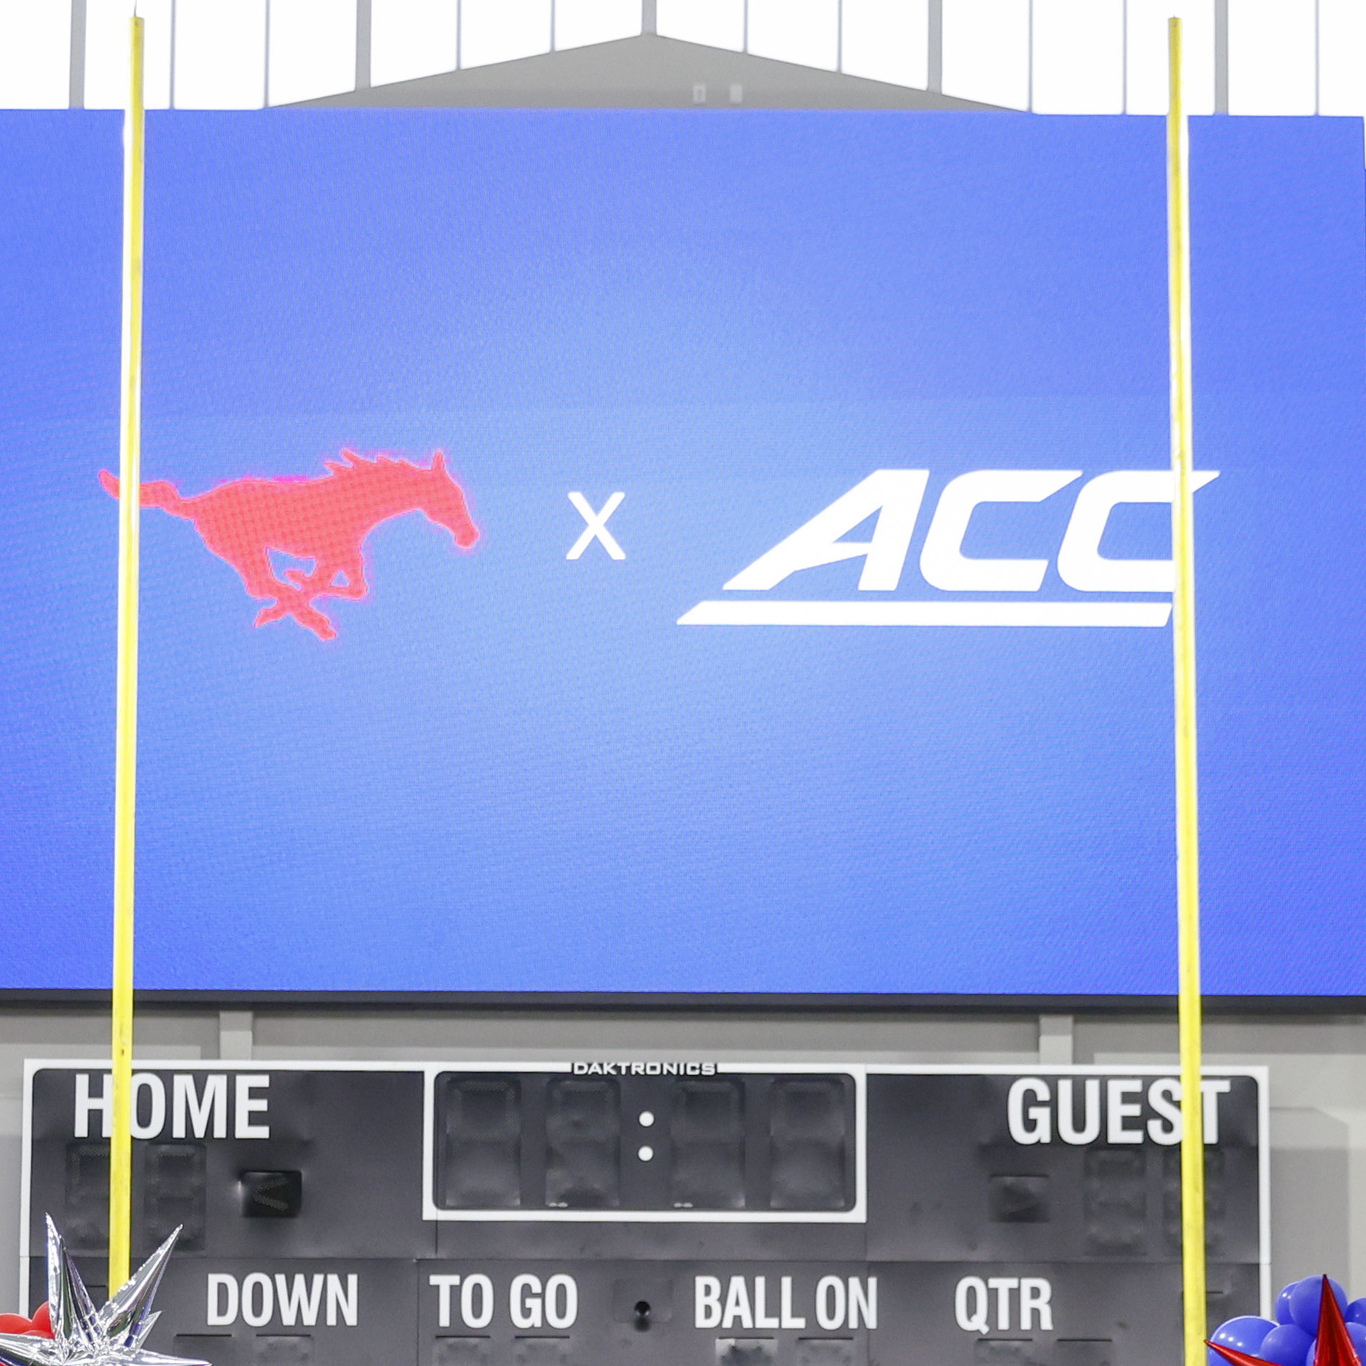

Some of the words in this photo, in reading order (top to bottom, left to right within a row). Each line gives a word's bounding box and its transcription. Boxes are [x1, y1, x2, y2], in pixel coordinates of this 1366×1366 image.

[723, 469, 1221, 592] ACC
[573, 1062, 716, 1076] DAKTRONICS
[73, 1073, 270, 1140] HOME
[1007, 1077, 1232, 1146] GUEST
[207, 1272, 359, 1328] DOWN
[429, 1274, 495, 1328] TO
[509, 1274, 578, 1329] GO
[695, 1276, 805, 1330] BALL
[816, 1276, 878, 1330] ON
[955, 1277, 1053, 1335] QTR
